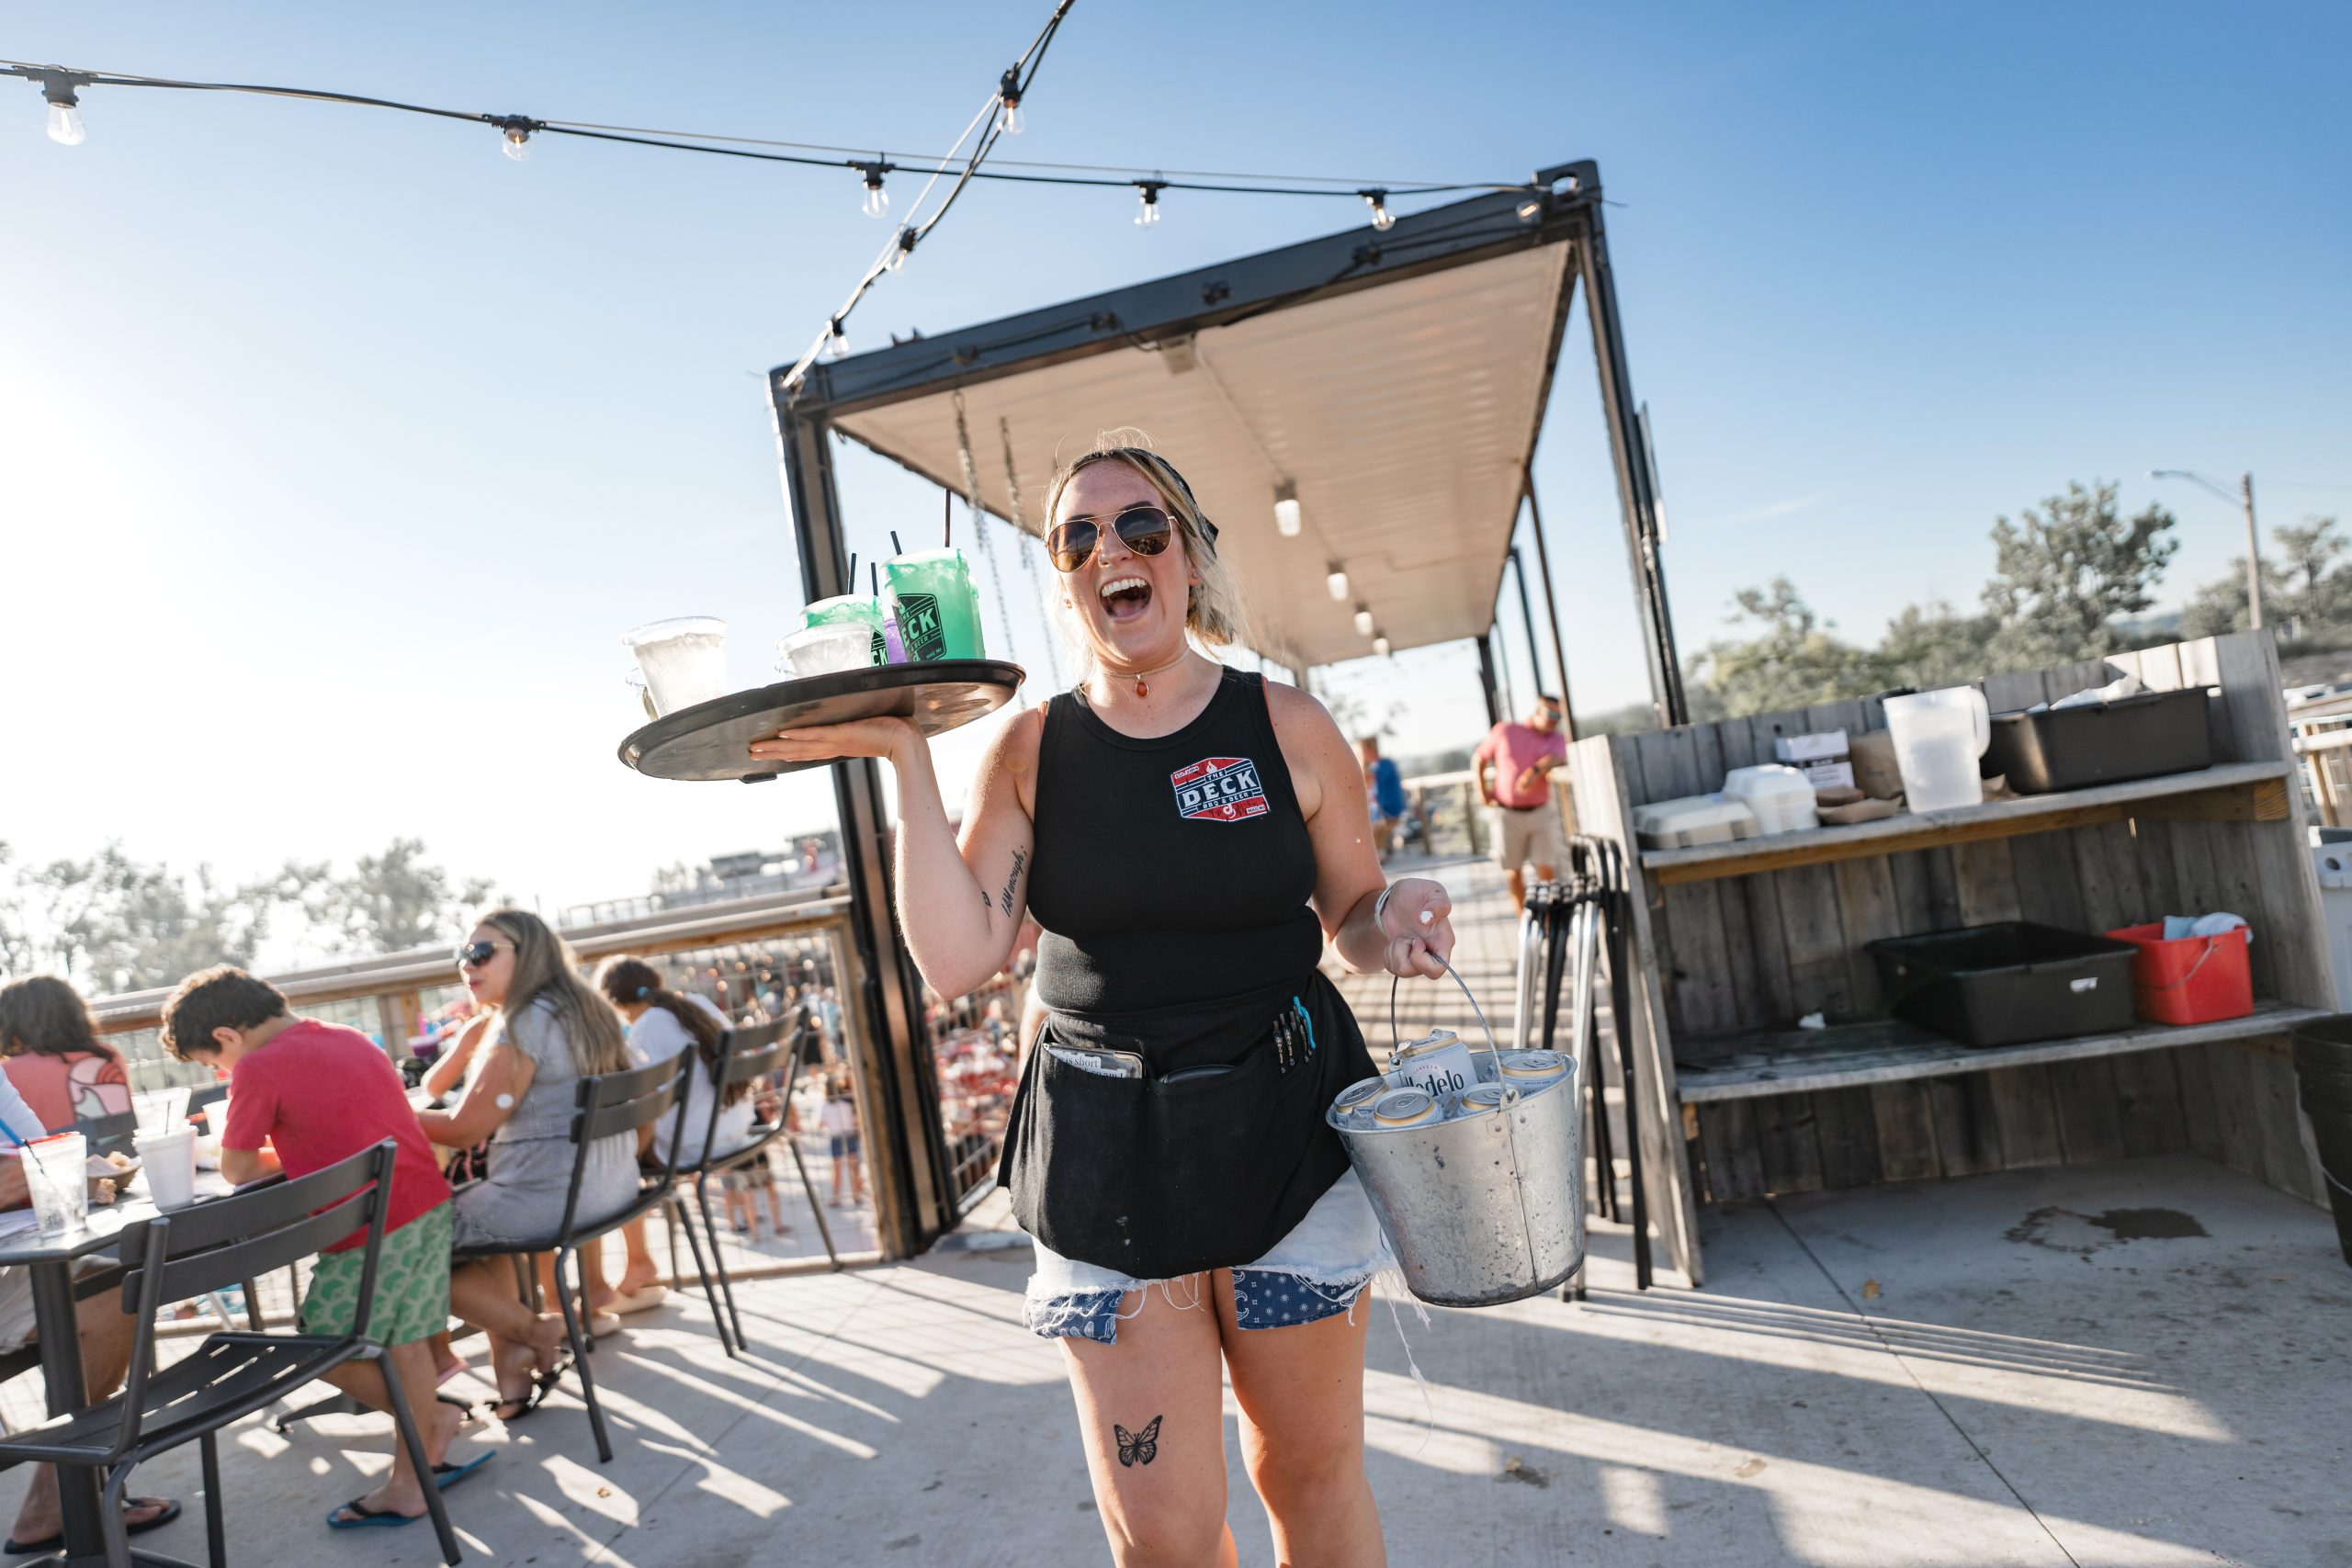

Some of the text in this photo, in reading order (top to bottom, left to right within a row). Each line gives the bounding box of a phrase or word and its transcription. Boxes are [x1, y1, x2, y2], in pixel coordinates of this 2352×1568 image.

[900, 607, 936, 648] ECK
[1206, 772, 1224, 781] THE
[1182, 770, 1256, 807] DECK
[1203, 800, 1219, 809] BBQ
[1228, 792, 1249, 802] BEER
[1001, 887, 1014, 913] AM
[1075, 1055, 1099, 1068] short
[1413, 1065, 1438, 1075] CERVEZA
